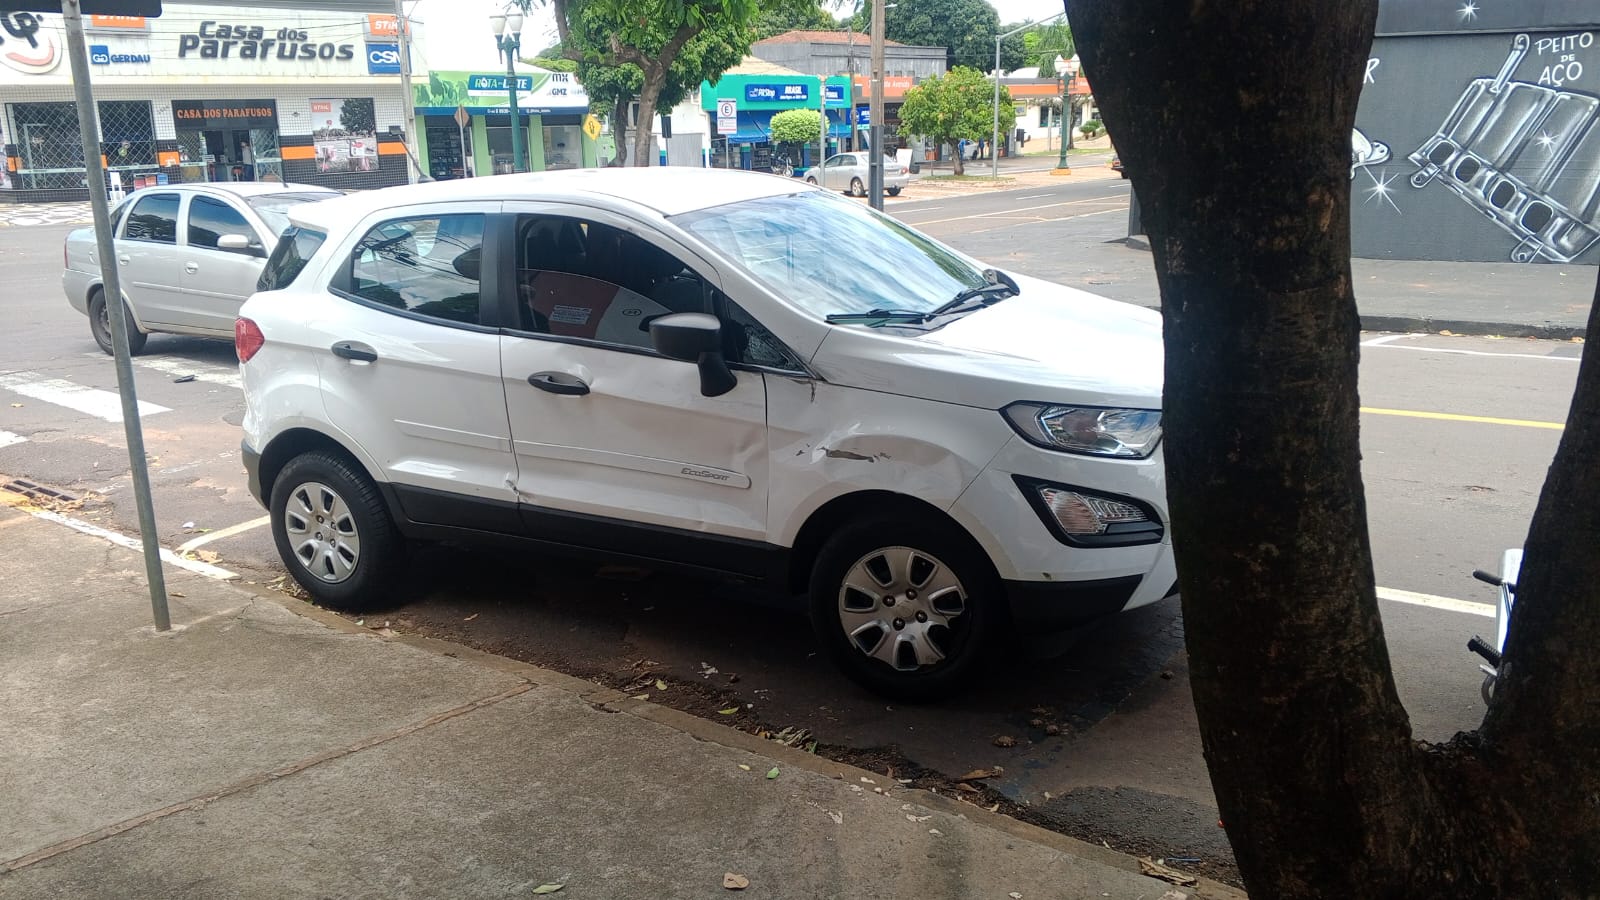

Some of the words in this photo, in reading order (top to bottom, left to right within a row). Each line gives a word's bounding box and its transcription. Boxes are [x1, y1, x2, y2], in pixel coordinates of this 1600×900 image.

[199, 20, 264, 39] Casa
[277, 27, 308, 41] dos
[178, 34, 355, 60] Parafusos
[1534, 32, 1594, 56] PEITO
[111, 54, 151, 63] GERDAU
[1560, 53, 1575, 63] DE
[1537, 61, 1583, 88] AÇO
[474, 77, 498, 88] ROTA
[502, 78, 528, 89] LTE
[177, 108, 202, 119] CASA
[204, 108, 221, 118] DOS
[223, 107, 272, 118] PARAFUSOS
[724, 105, 730, 113] E
